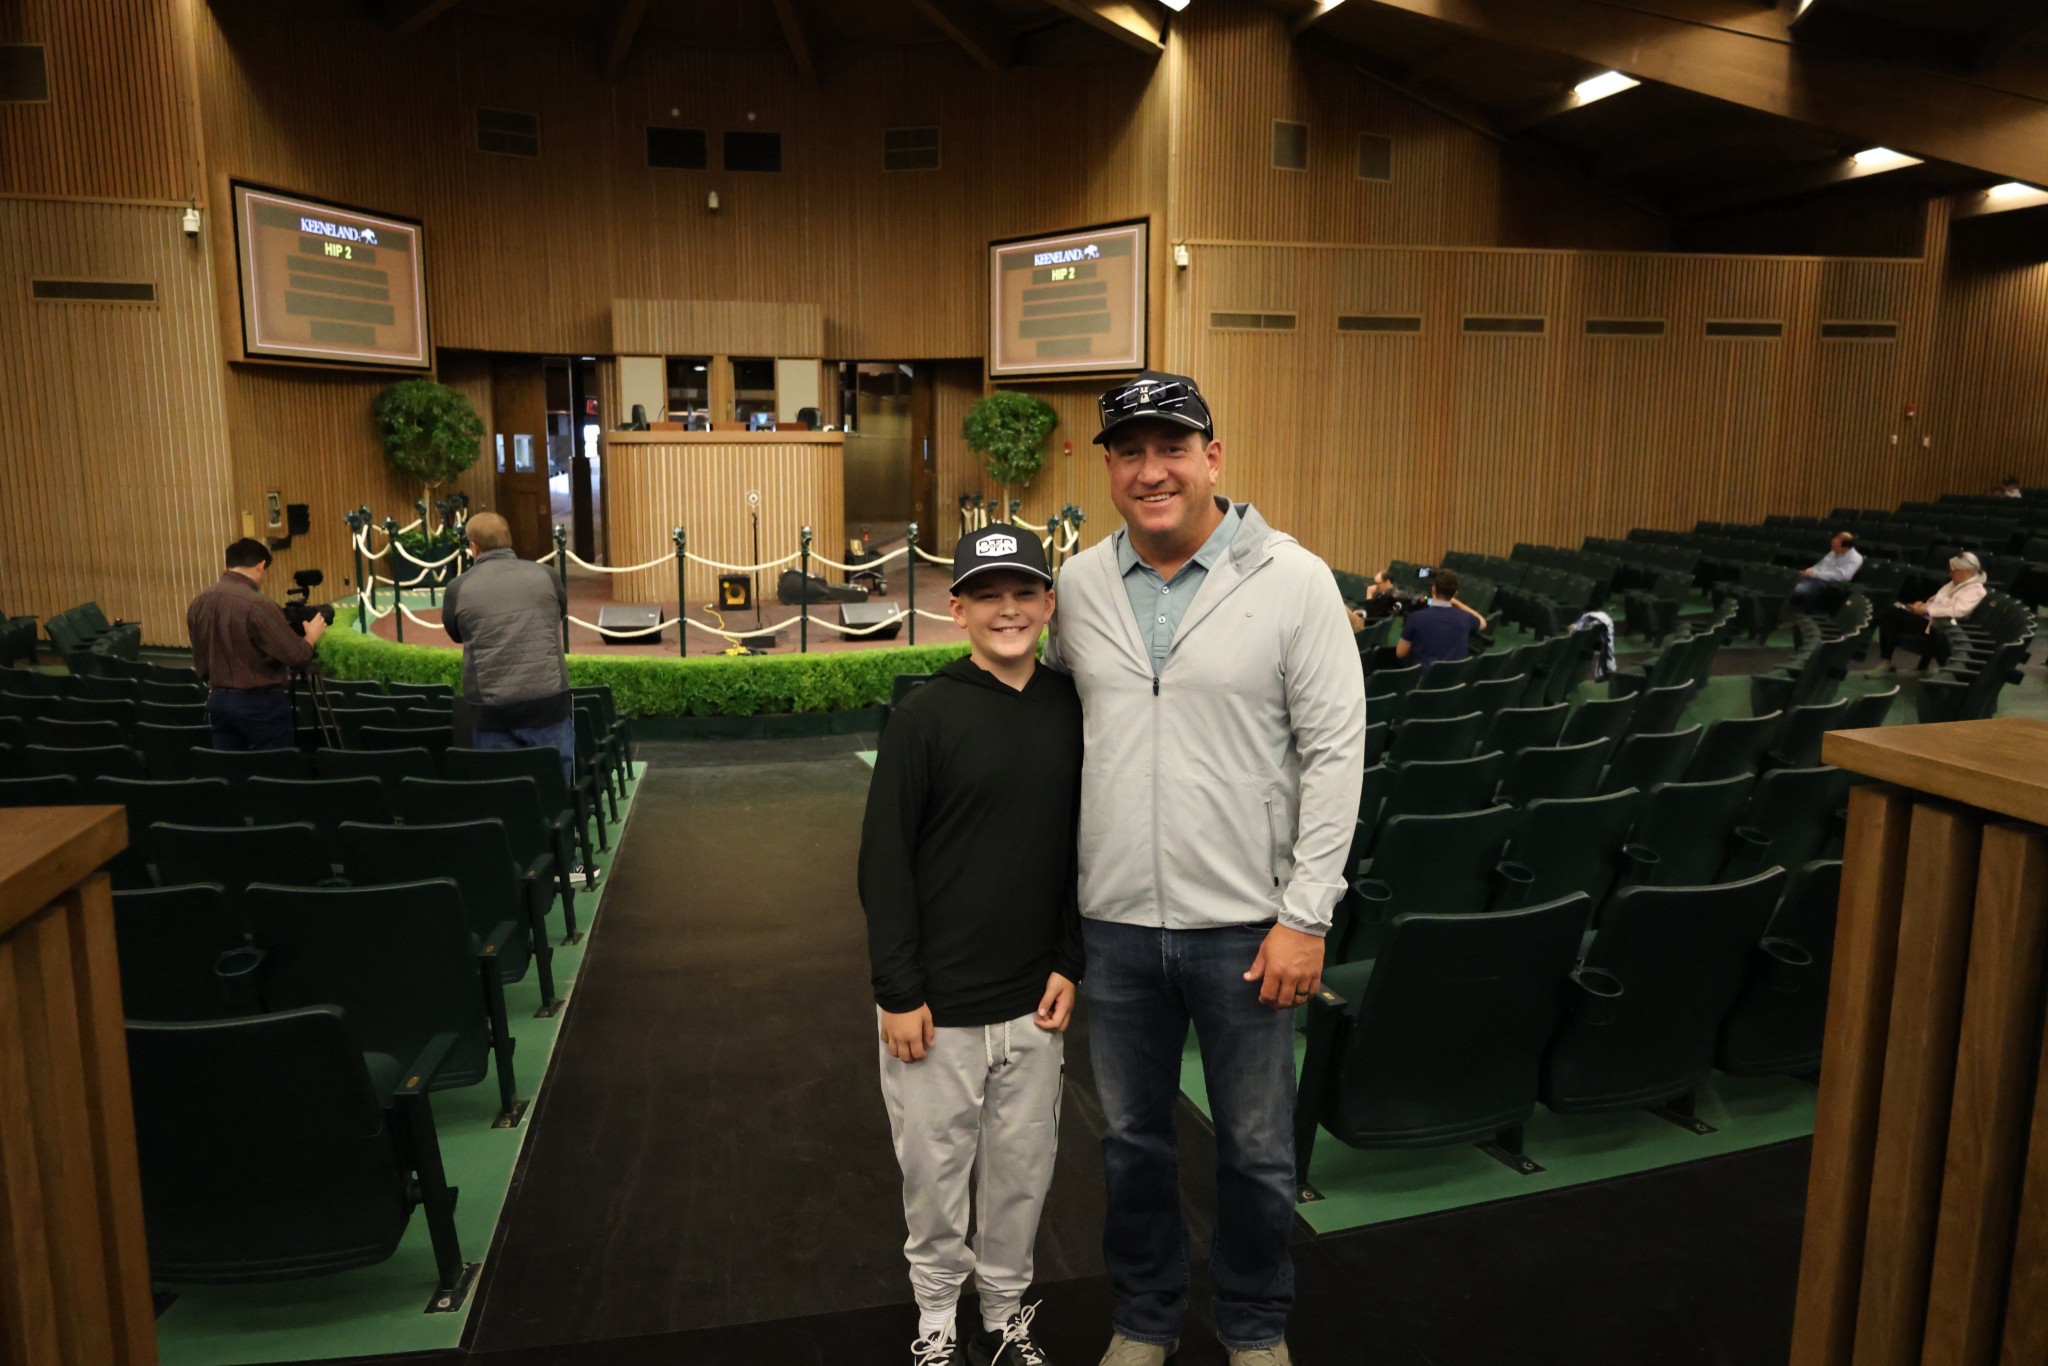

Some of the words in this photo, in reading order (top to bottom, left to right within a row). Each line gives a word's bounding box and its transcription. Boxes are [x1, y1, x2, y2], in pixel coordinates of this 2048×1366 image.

[300, 217, 359, 241] KEENELAND
[324, 242, 343, 257] HIP
[345, 246, 352, 260] 2
[1034, 248, 1082, 266] KEENELAND
[1051, 268, 1067, 281] HIP
[1069, 267, 1075, 280] 2
